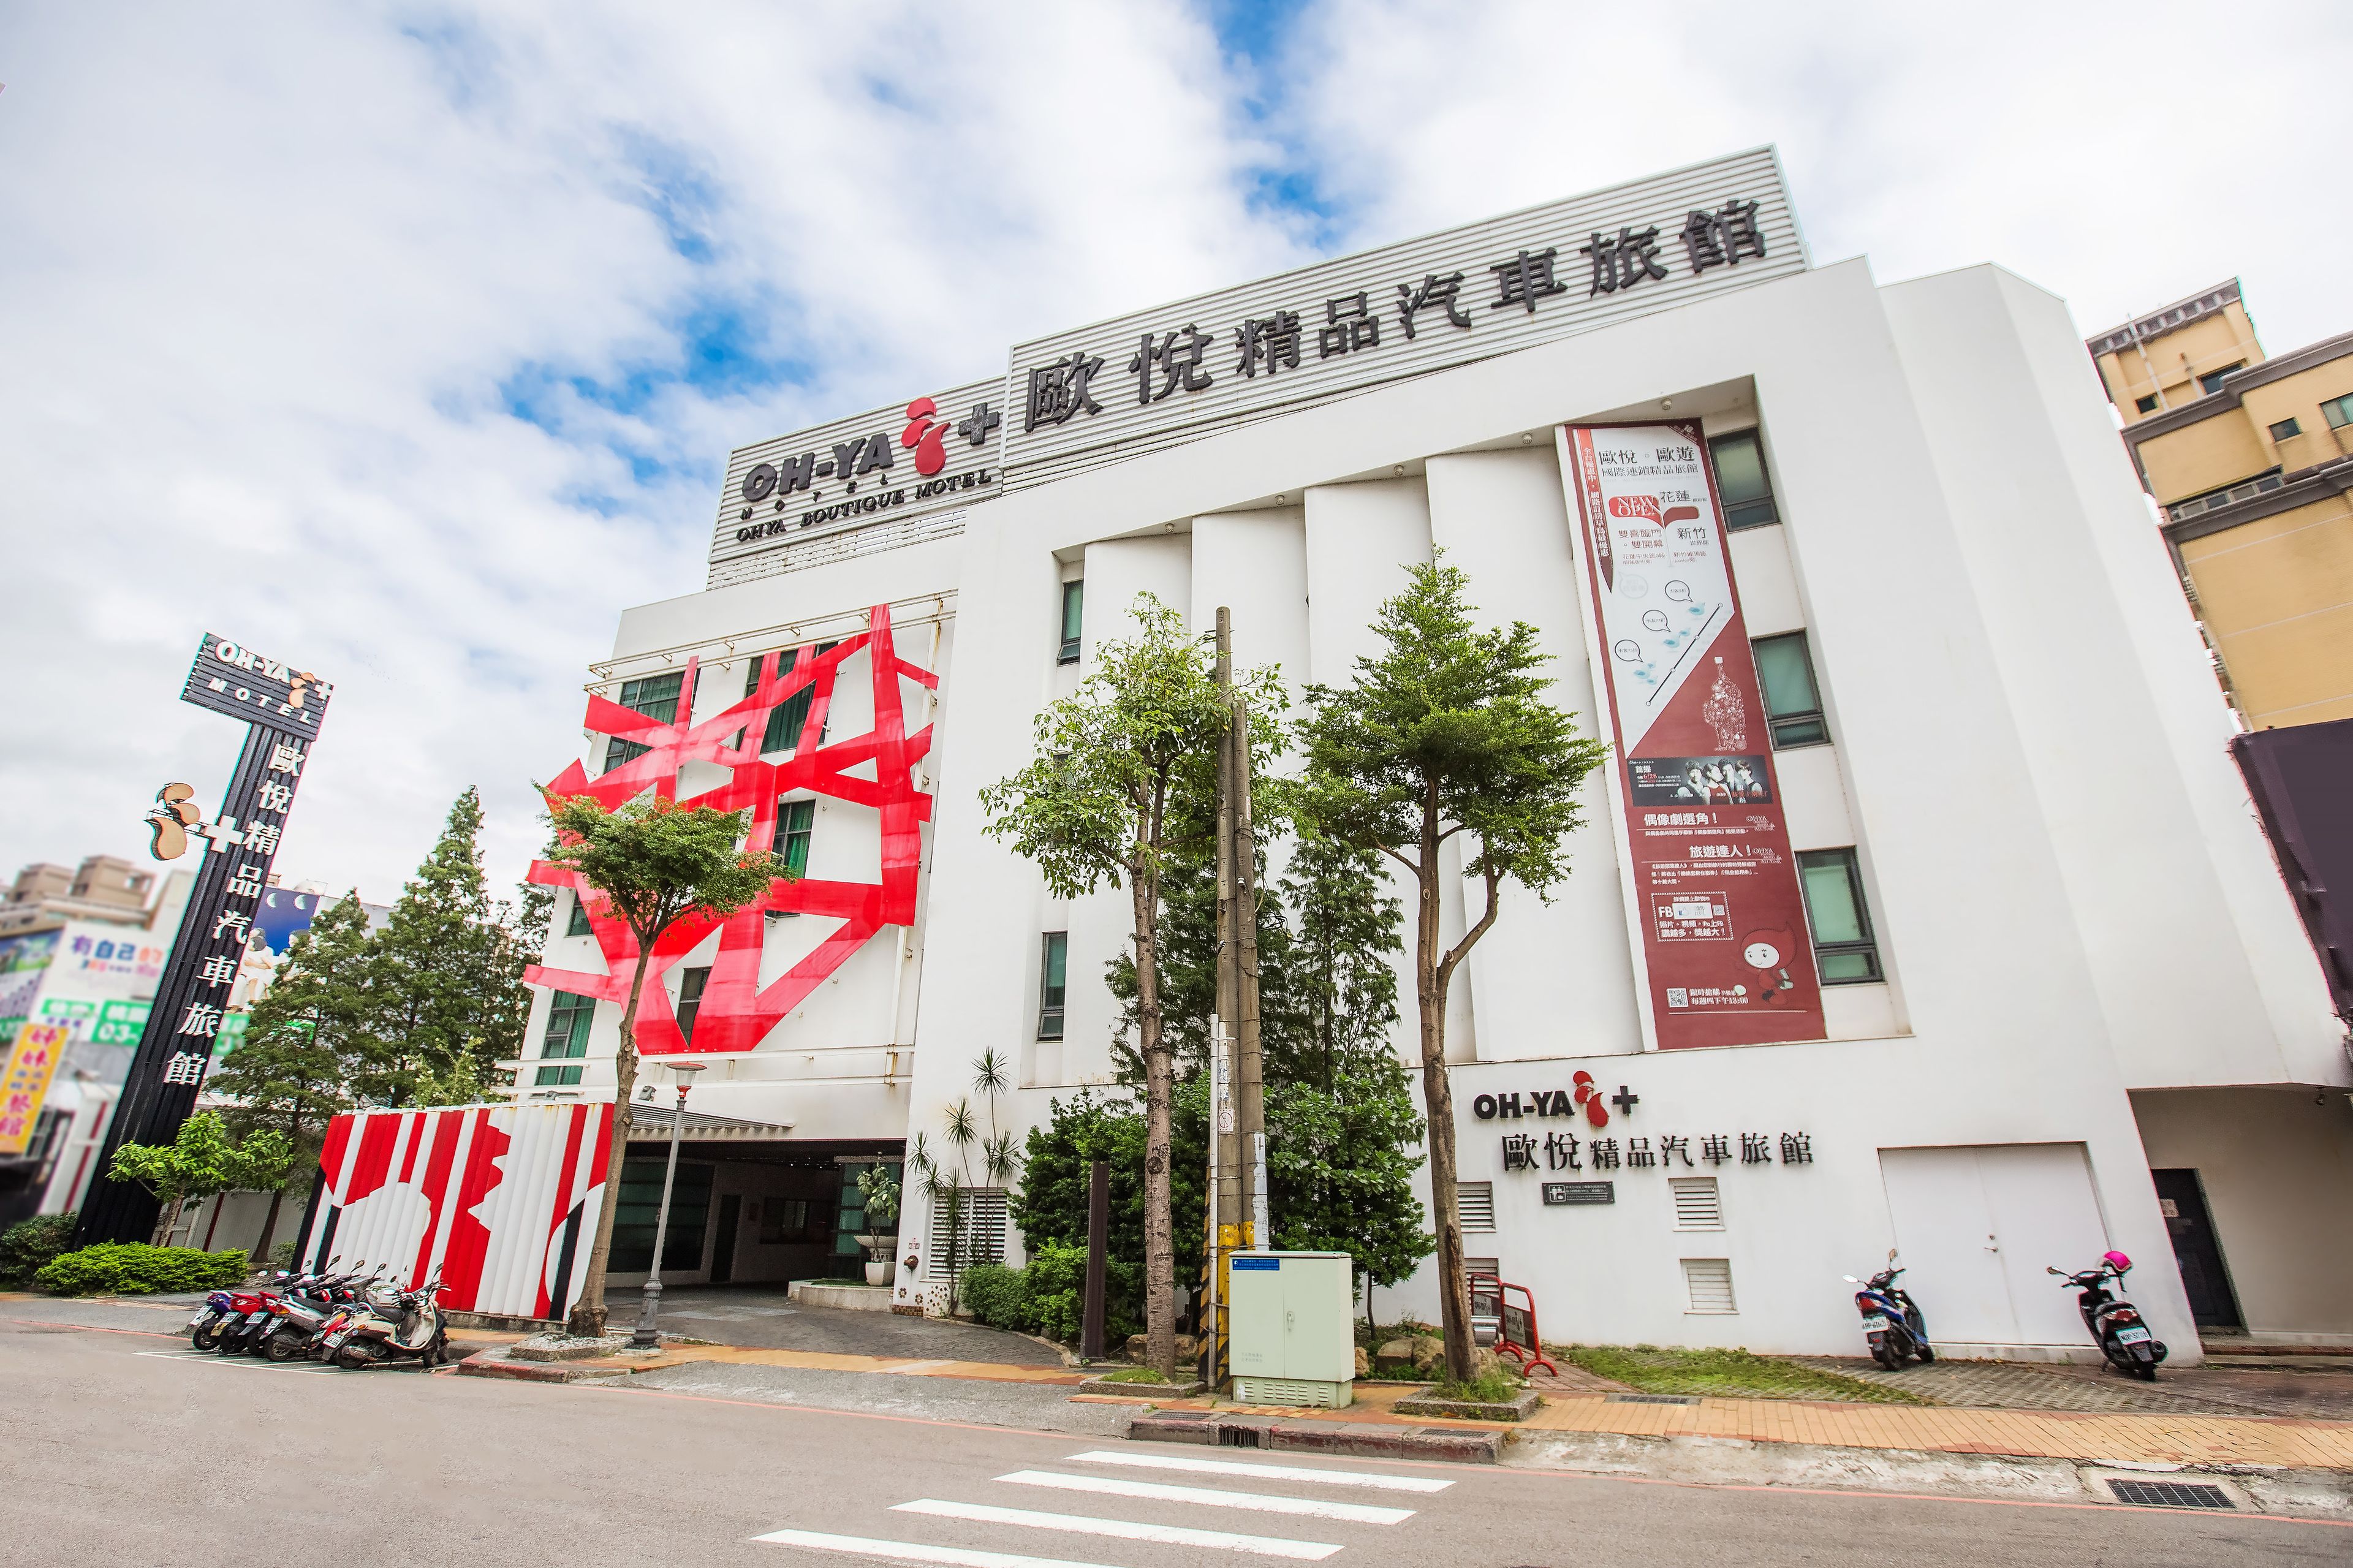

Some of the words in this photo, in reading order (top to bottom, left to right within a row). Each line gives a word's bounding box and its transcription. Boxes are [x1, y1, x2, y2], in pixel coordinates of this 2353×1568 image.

[1025, 199, 1767, 433] 歐悅精品汽車旅館
[741, 432, 894, 502] OH-YA
[736, 519, 787, 542] OHYA
[800, 489, 904, 527] BOUTIQUE
[915, 468, 991, 499] MOTEL
[1618, 496, 1655, 507] NEW
[1618, 505, 1661, 517] OPEN
[1659, 490, 1691, 503] 花蓮
[1618, 529, 1662, 538] 雙喜臨門
[1677, 528, 1707, 539] 新竹
[216, 640, 291, 684] OH-YA
[208, 678, 312, 724] MOTEL
[163, 743, 306, 1086] 歐悅精品汽車旅館
[1658, 906, 1673, 918] FB
[1473, 1089, 1575, 1119] OH-YA
[1502, 1131, 1814, 1173] 歐悅精品汽車旅館
